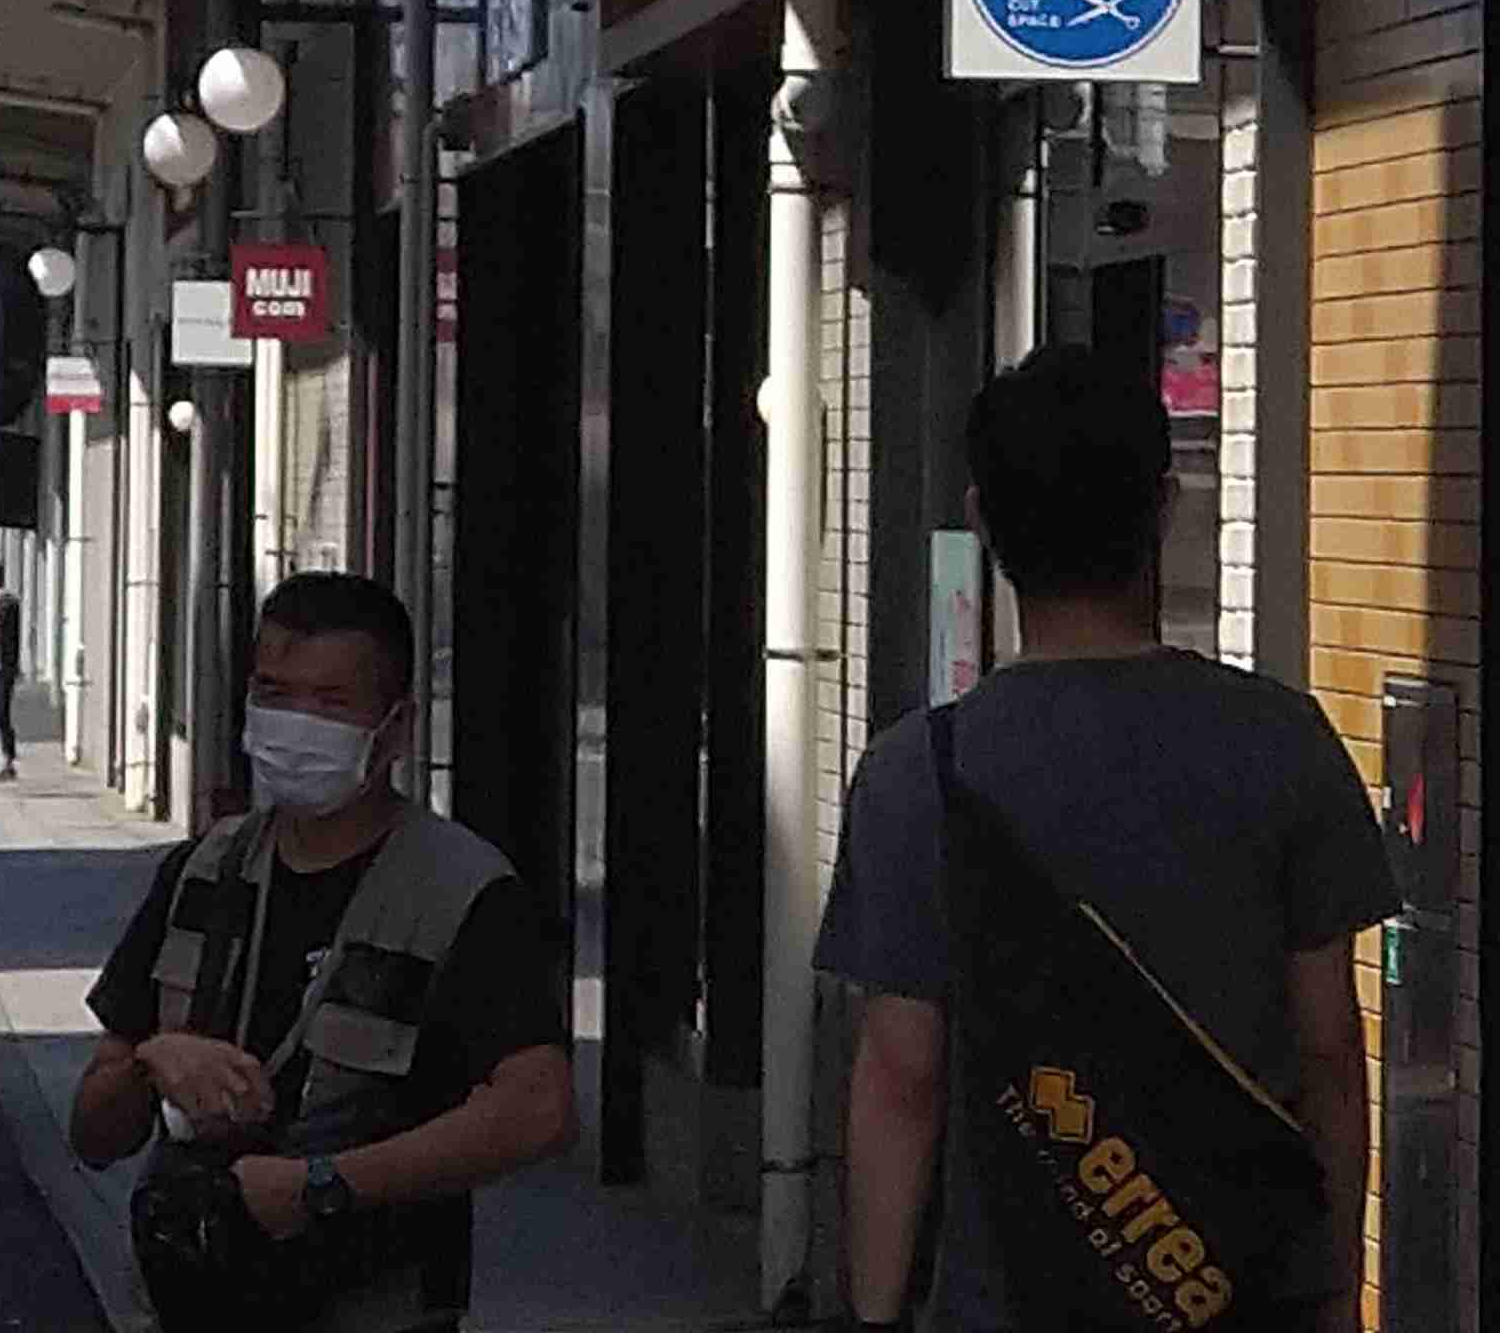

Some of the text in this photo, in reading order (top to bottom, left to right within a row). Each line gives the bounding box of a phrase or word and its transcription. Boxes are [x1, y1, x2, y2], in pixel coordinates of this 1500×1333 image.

[1007, 13, 1062, 29] SPACE
[245, 268, 313, 299] MUJI
[252, 300, 306, 318] com
[1077, 1135, 1234, 1330] errea
